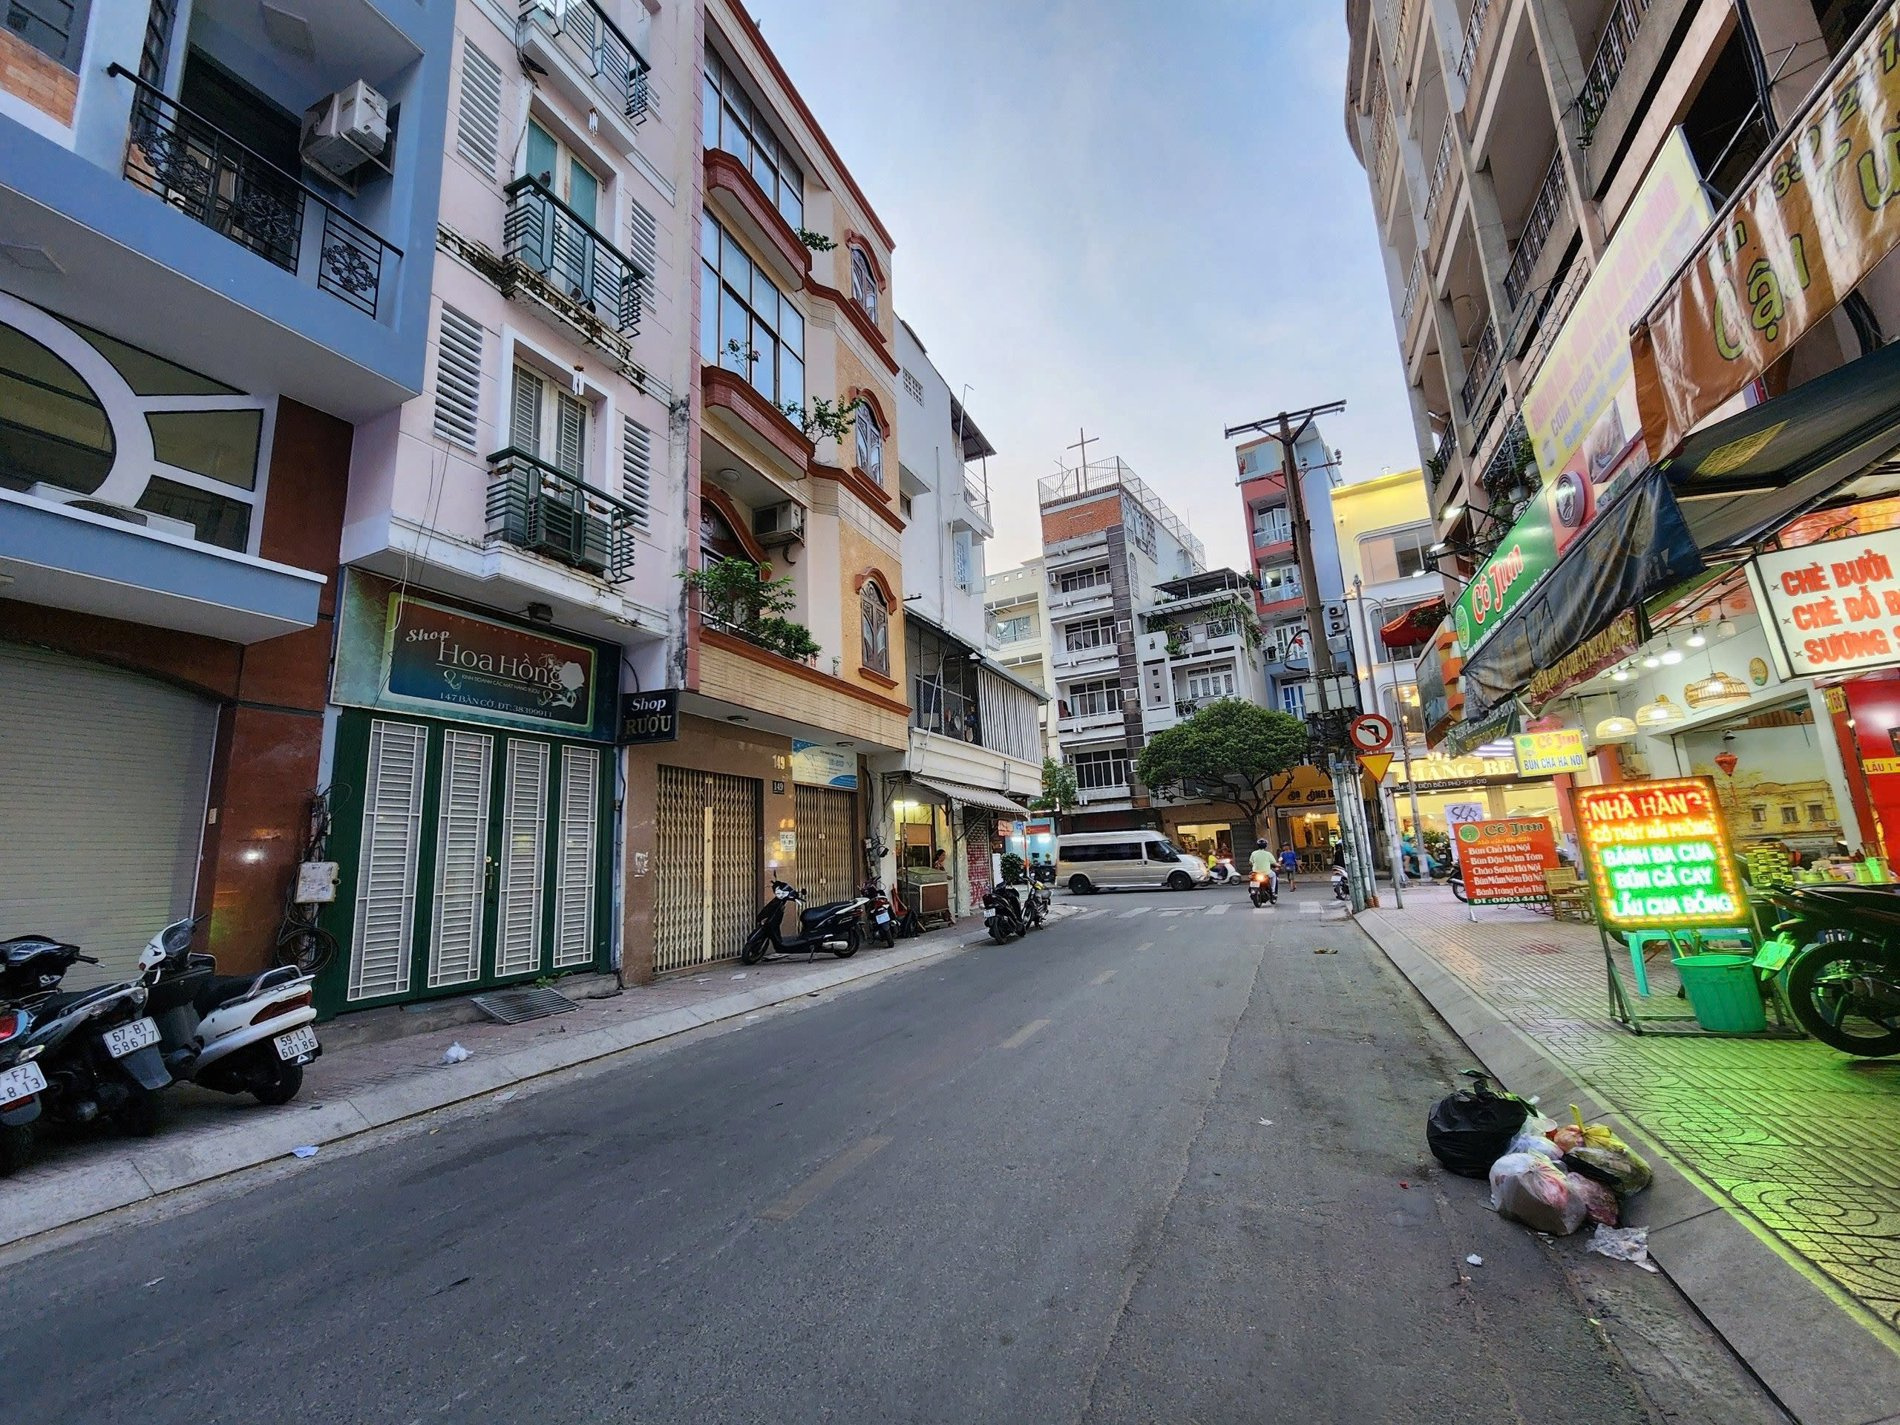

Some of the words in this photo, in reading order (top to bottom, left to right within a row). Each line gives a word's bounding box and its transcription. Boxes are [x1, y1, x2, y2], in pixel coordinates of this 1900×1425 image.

[1781, 561, 1831, 596] CHÈ
[1830, 548, 1894, 588] BƯỞI
[1472, 574, 1492, 624] Cô
[1792, 595, 1843, 631] CHÈ
[406, 628, 449, 643] Shop
[438, 641, 493, 673] Hoa
[499, 653, 563, 690] Hồng
[440, 691, 457, 701] 147
[631, 697, 667, 711] Shop
[772, 754, 785, 769] 149
[773, 783, 784, 791] 149
[1590, 793, 1638, 821] NHÀ
[1485, 823, 1506, 837] Cô
[1679, 842, 1715, 861] CUA
[1680, 866, 1713, 886] CAY
[1647, 896, 1682, 915] CUA
[112, 1022, 147, 1042] 67-B1
[280, 1030, 308, 1047] 59-L1
